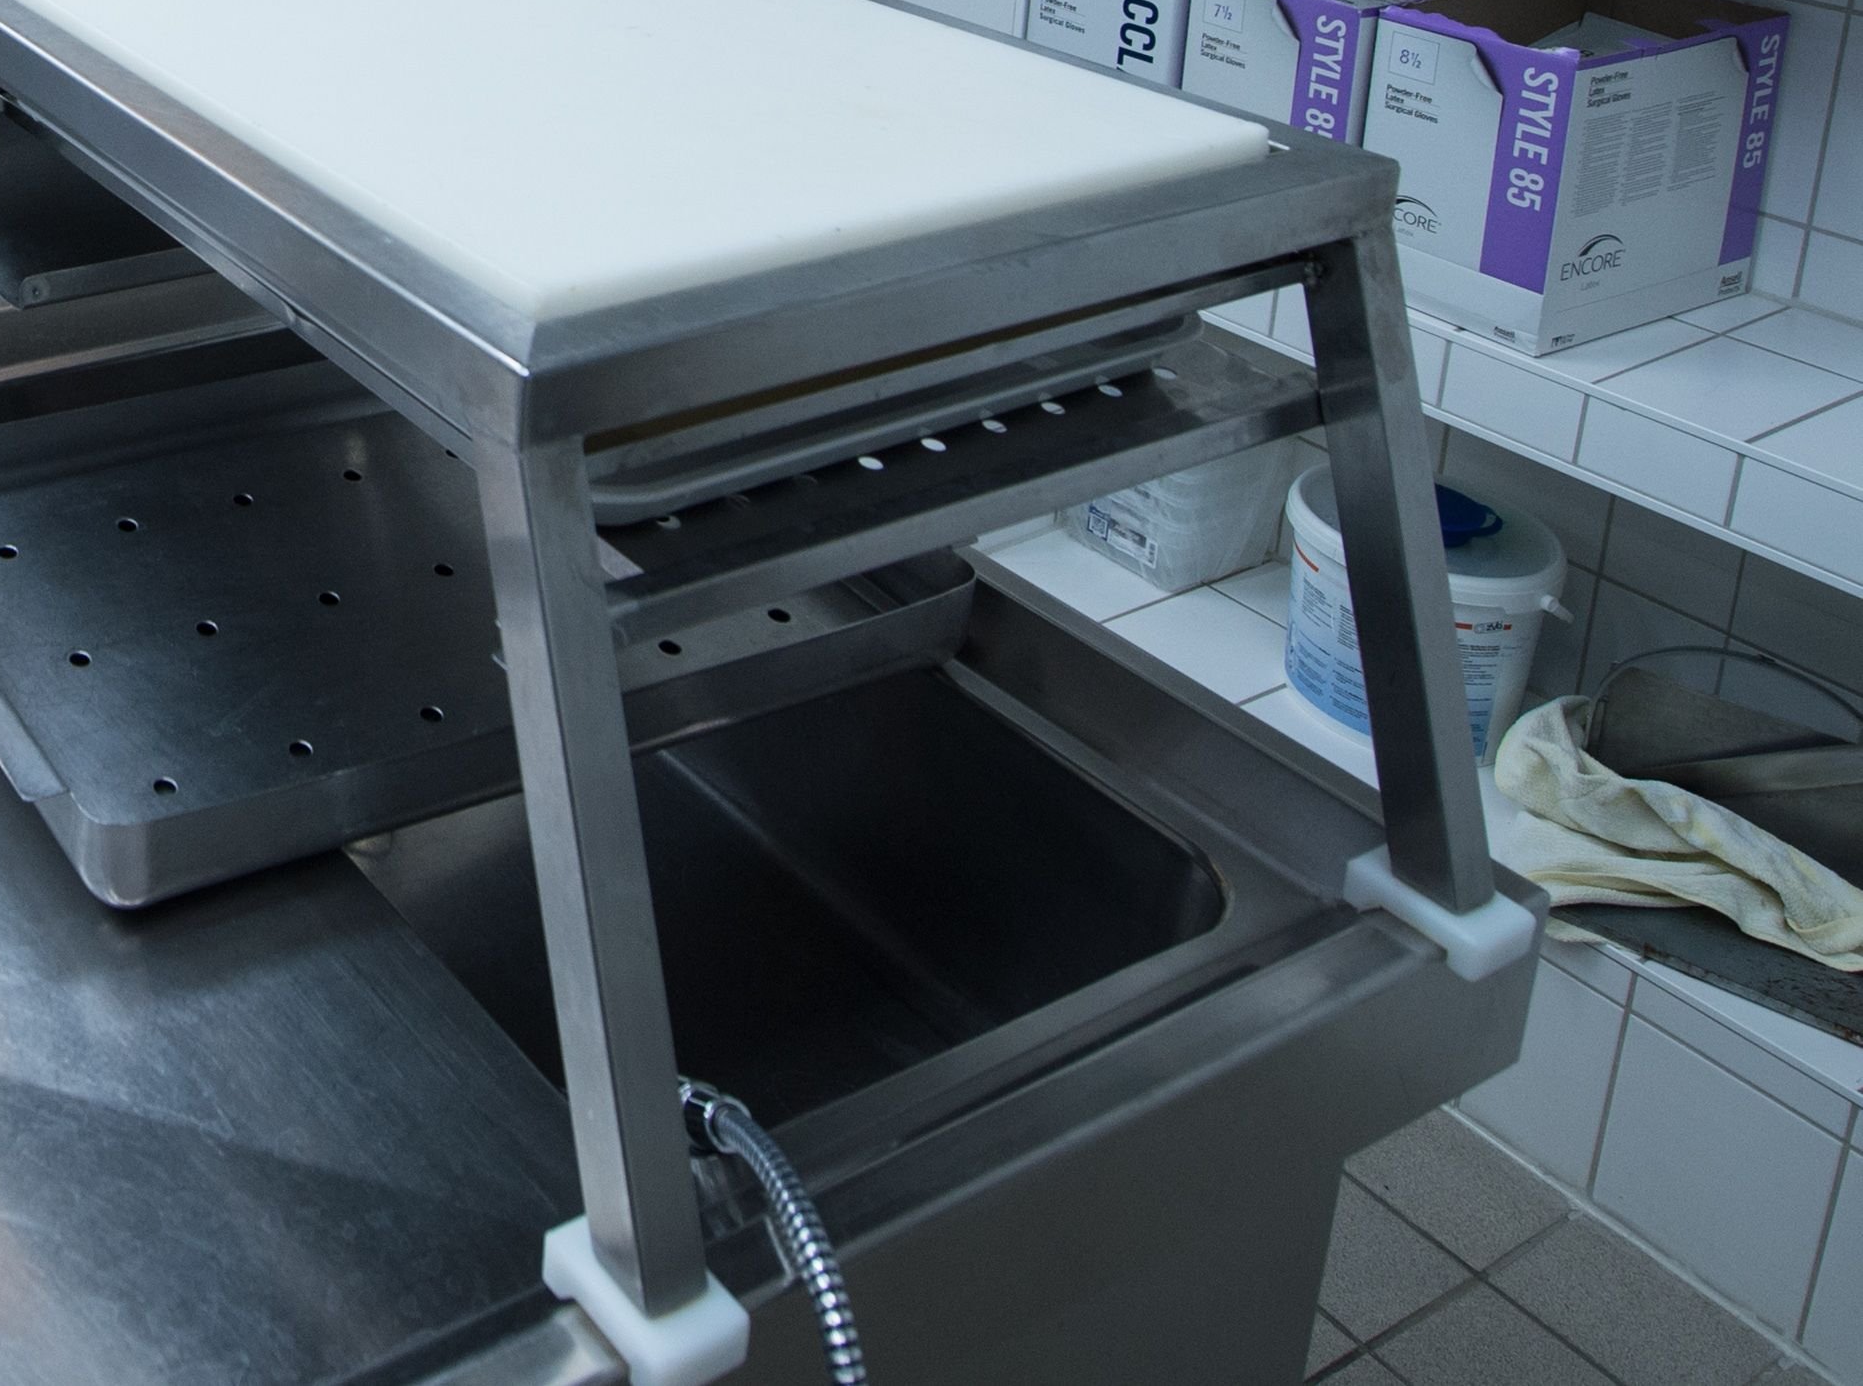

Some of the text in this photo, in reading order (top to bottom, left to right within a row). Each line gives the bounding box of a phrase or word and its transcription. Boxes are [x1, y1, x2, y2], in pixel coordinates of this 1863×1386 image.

[1039, 3, 1057, 15] Latex
[1201, 32, 1241, 51] Powder-Free
[1308, 14, 1347, 105] STYLE
[1590, 71, 1629, 86] Powder-Free
[1385, 92, 1405, 105] Latex
[1386, 83, 1433, 104] Powder-Free
[1588, 86, 1605, 97] Latex
[1742, 34, 1781, 169] STYLE 85
[1384, 100, 1439, 124] Surgical Gloves
[1506, 66, 1559, 212] STYLE 85
[1560, 249, 1623, 281] ENCORE
